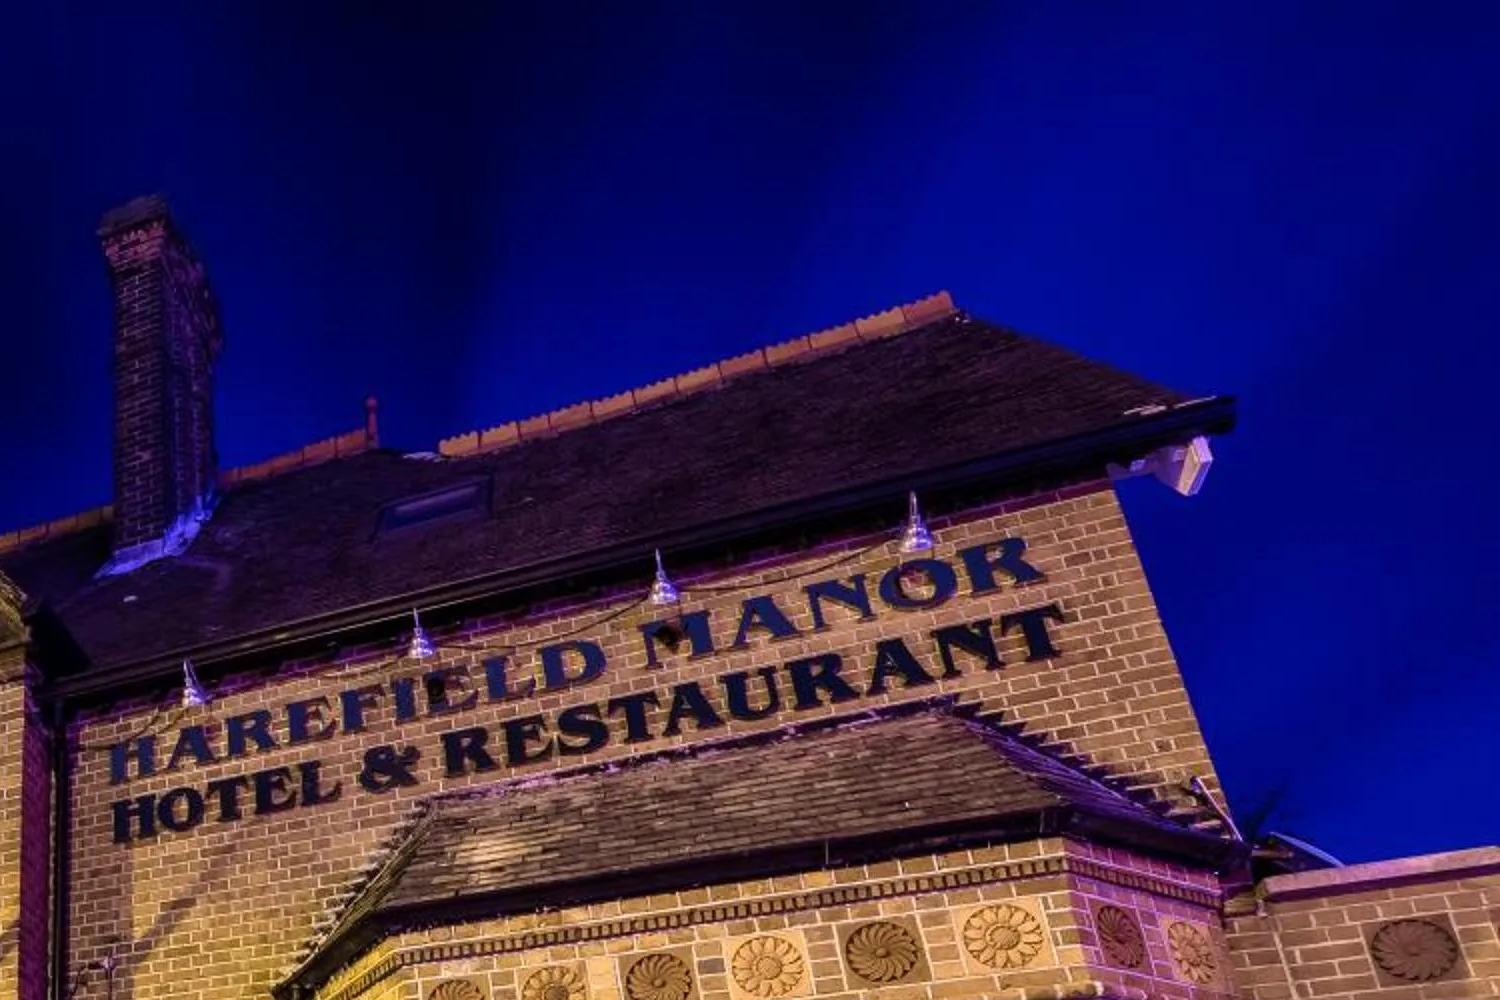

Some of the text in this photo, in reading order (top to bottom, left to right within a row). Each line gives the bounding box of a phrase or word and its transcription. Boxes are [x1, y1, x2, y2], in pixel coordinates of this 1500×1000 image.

[108, 537, 1048, 786] HAREFIELD MANOR
[112, 603, 1065, 844] HOTEL & RESTAURANT
